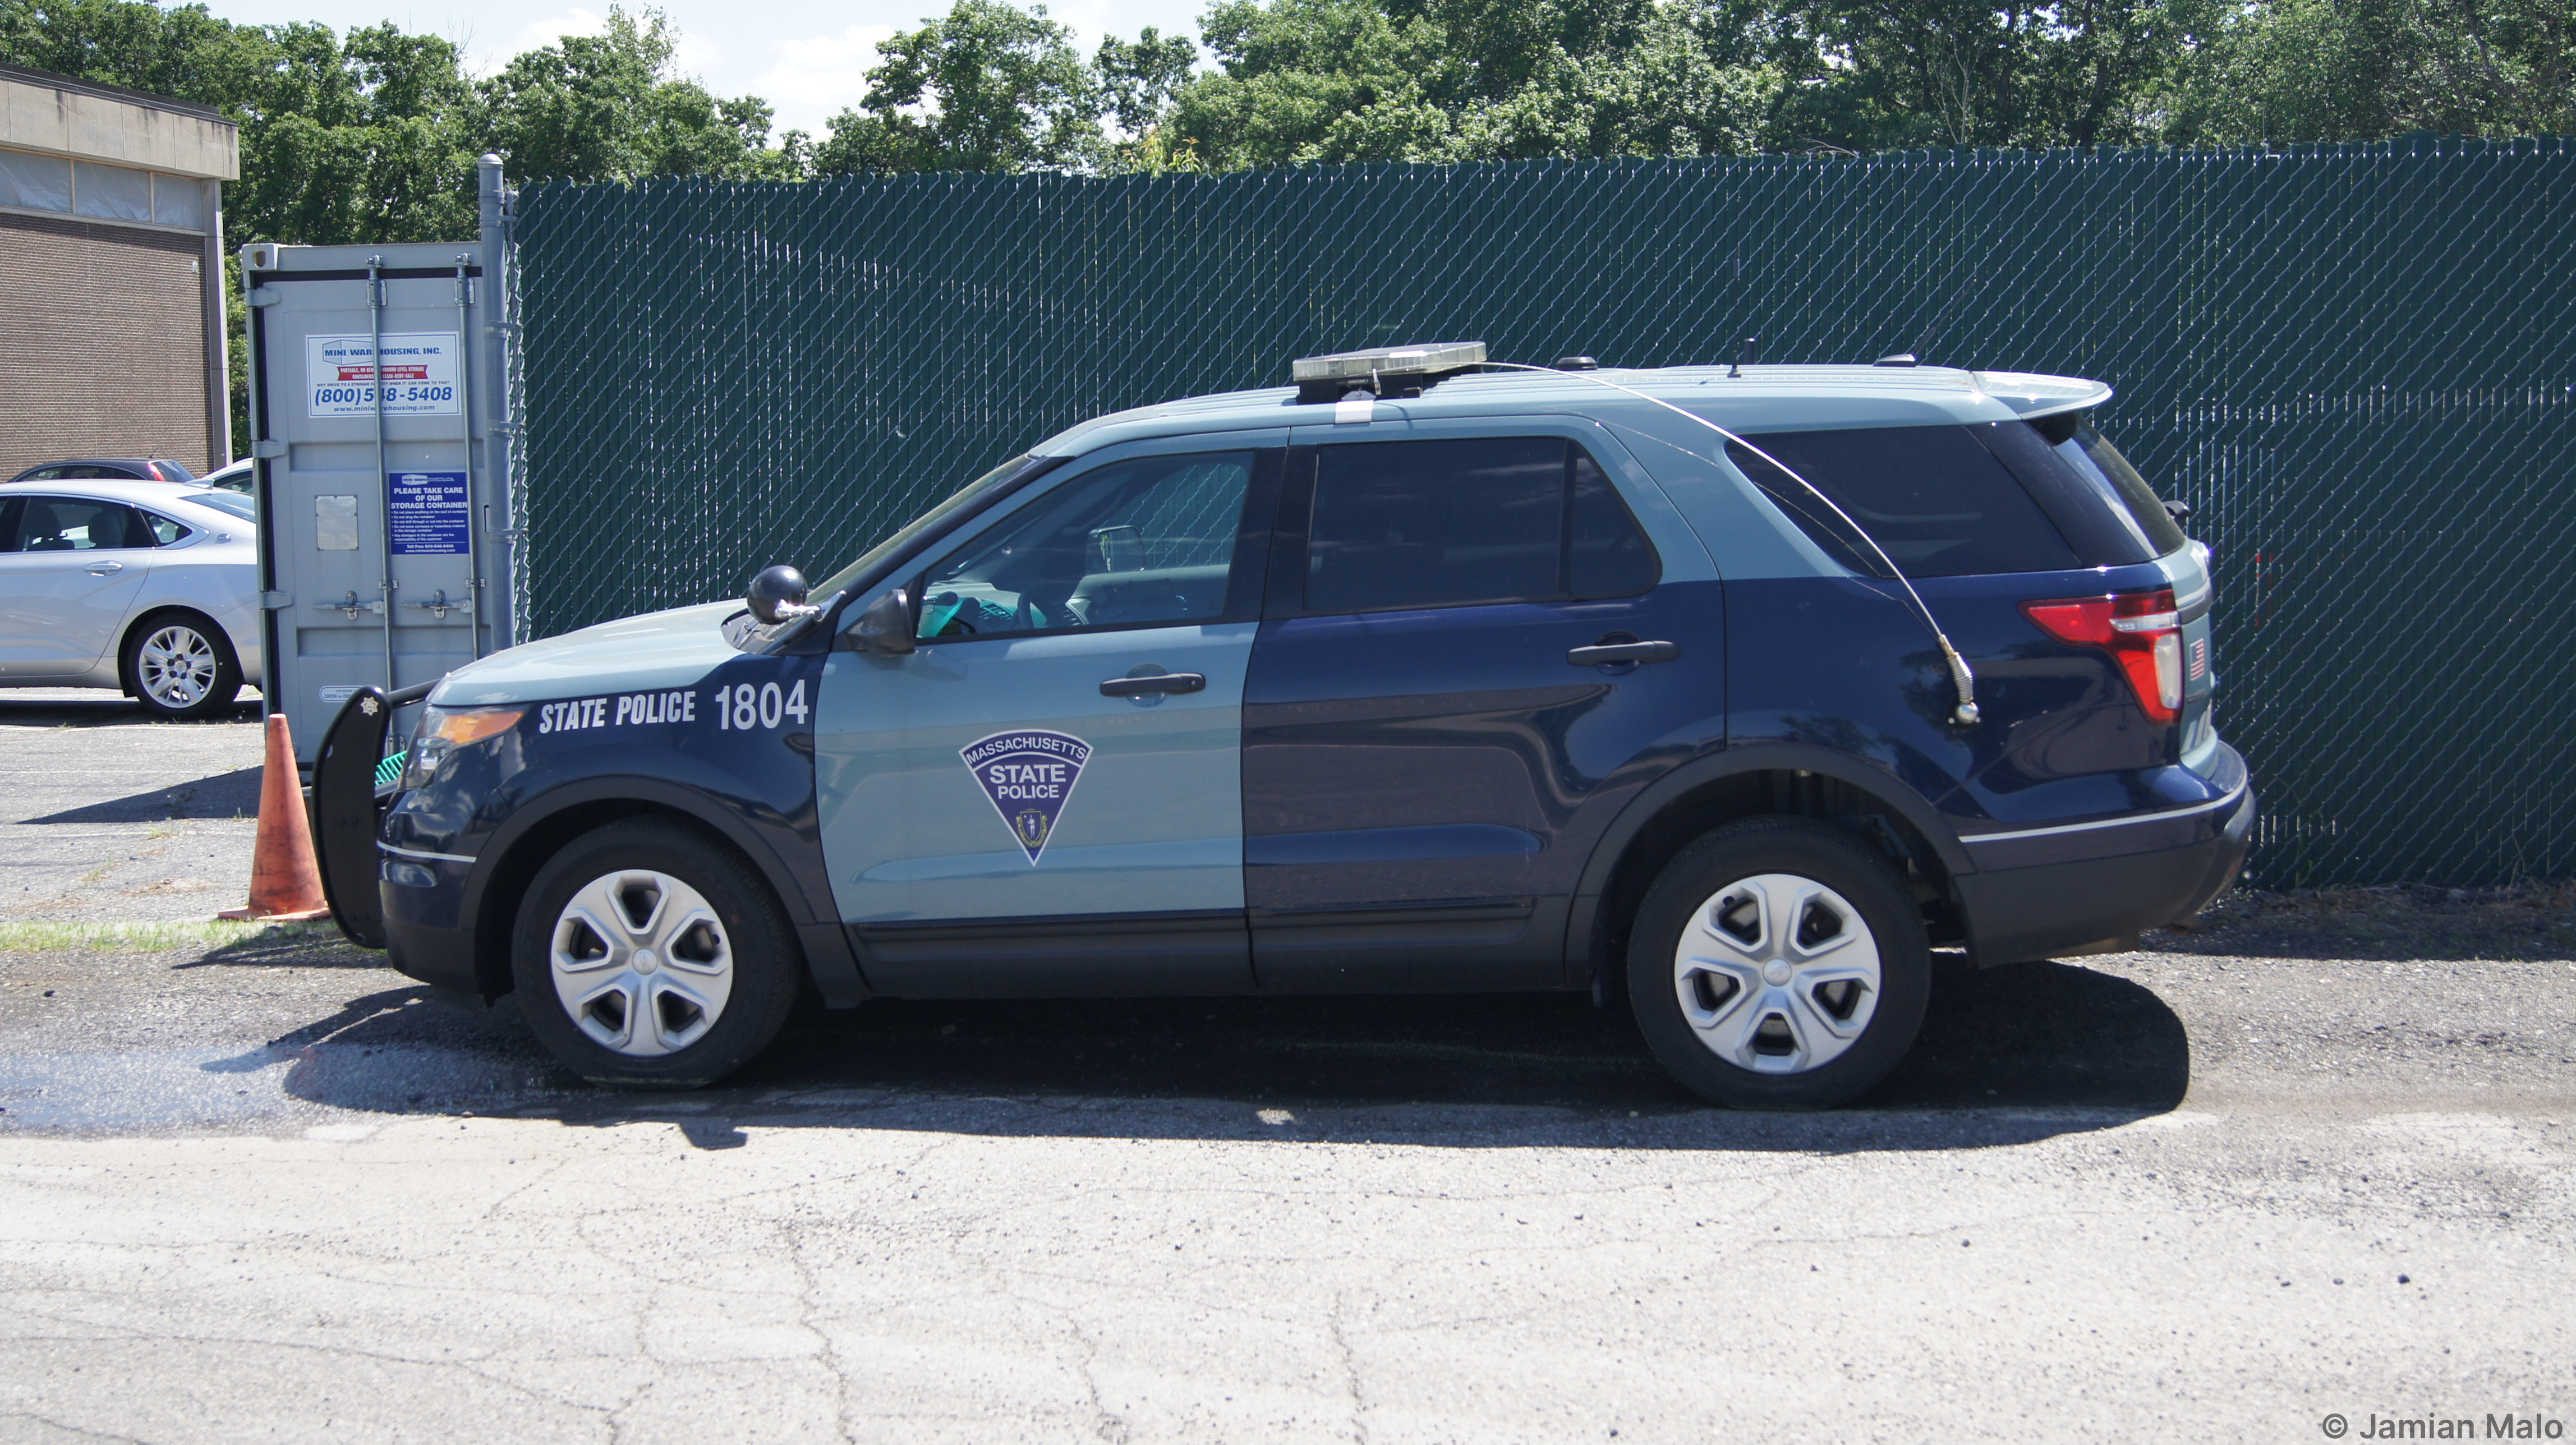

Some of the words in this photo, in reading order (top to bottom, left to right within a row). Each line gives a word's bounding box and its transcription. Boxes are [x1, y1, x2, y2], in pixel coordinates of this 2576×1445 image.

[539, 698, 607, 734] STATE
[615, 691, 696, 726] POLICE
[715, 679, 808, 730] 1804
[965, 737, 1087, 765] MASSACHUSETTS
[989, 764, 1066, 784] STATE
[997, 784, 1060, 799] POLICE
